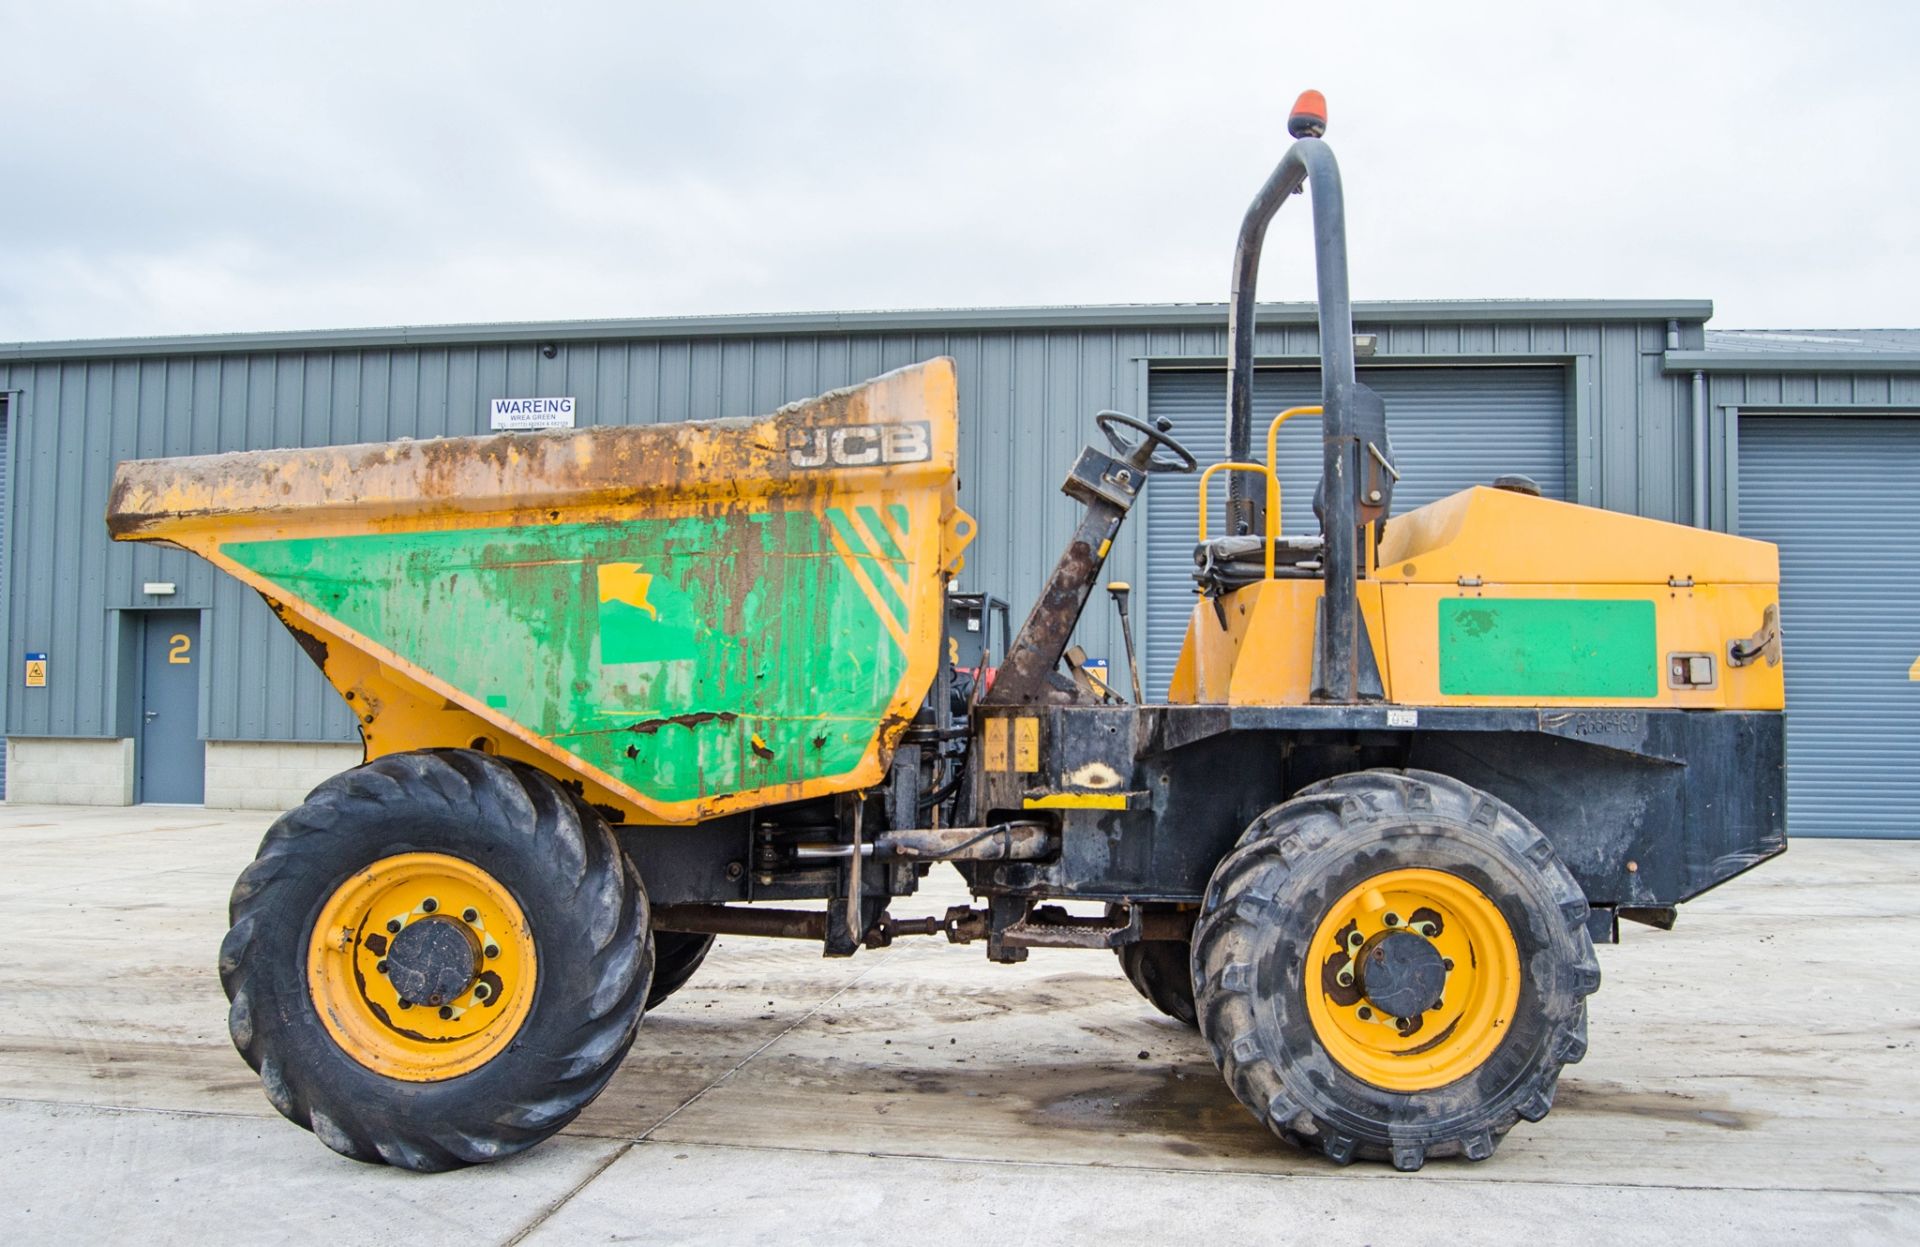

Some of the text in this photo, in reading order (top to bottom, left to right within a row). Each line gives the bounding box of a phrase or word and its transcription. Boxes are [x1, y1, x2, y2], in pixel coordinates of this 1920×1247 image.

[496, 400, 571, 413] WAREING
[789, 424, 929, 467] JCB
[169, 634, 191, 664] 2
